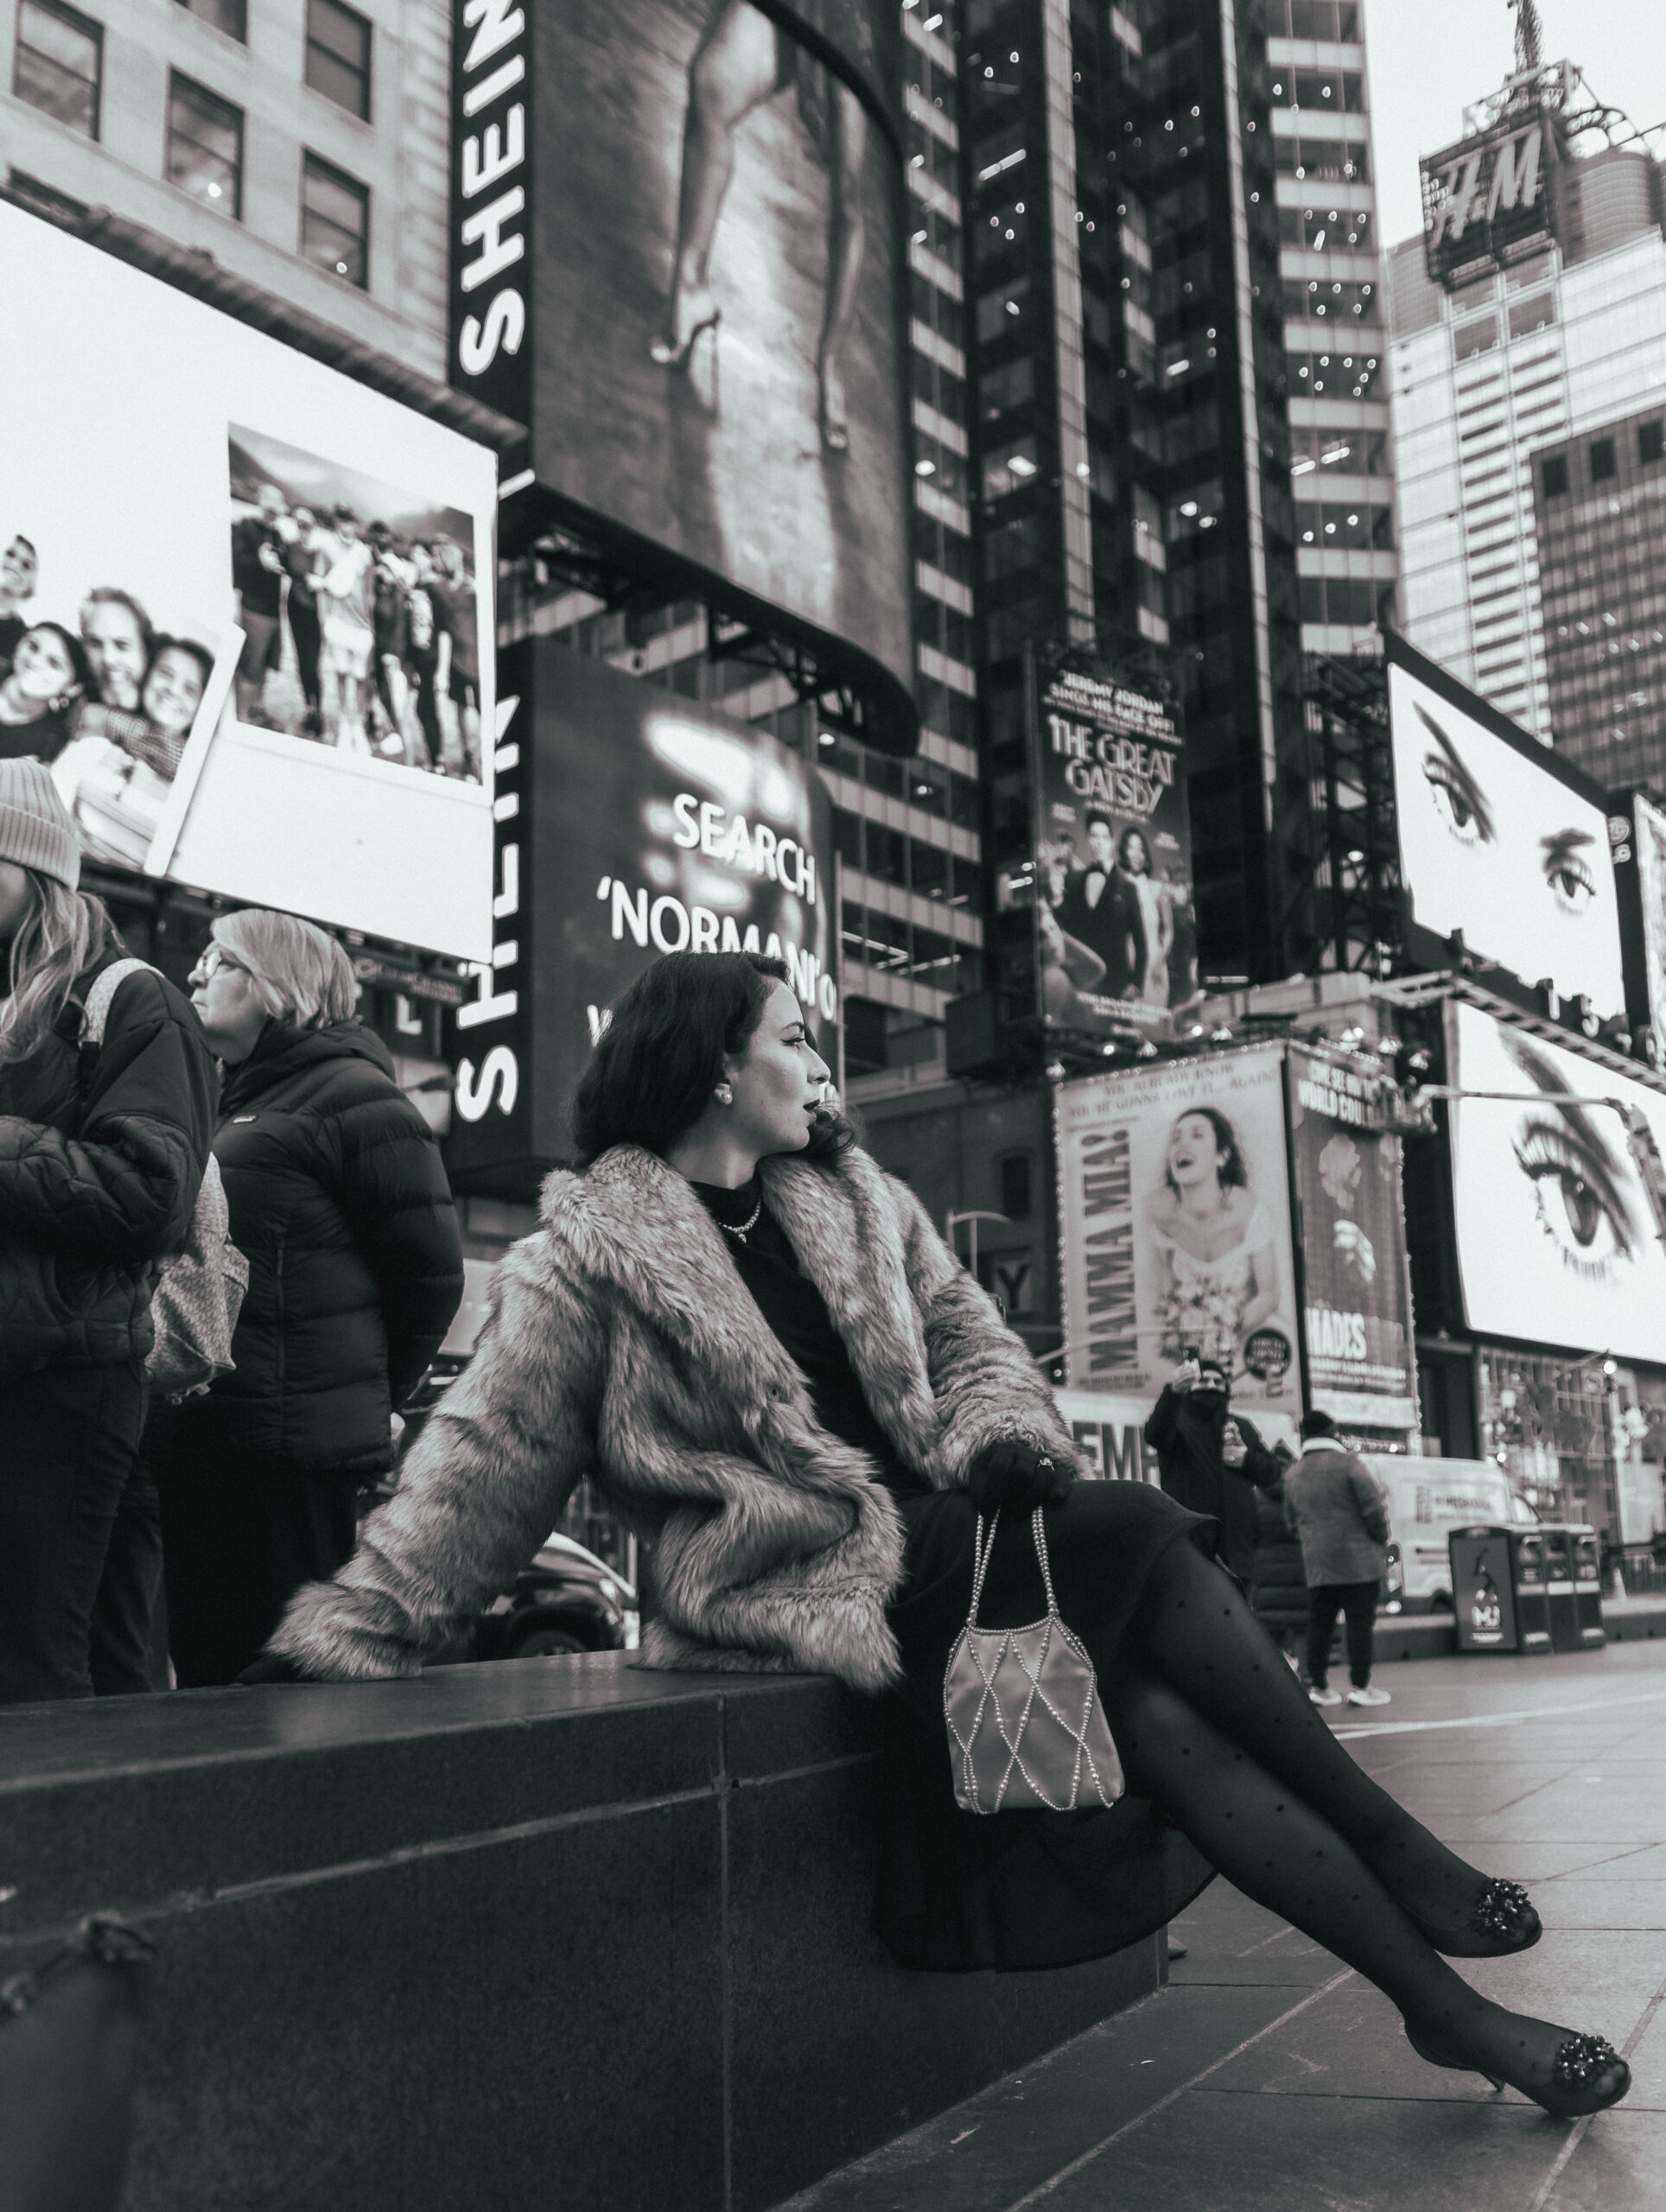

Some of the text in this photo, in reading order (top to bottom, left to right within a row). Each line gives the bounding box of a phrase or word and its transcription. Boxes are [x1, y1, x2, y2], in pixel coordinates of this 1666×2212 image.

[459, 0, 525, 376] SHEIN
[1048, 715, 1094, 762] THE
[1097, 734, 1177, 786] GREAT
[672, 793, 815, 905] SEARCH
[1195, 1064, 1235, 1079] KNOW
[1081, 1129, 1132, 1219] MIA!
[1086, 1223, 1138, 1374] MAMMA
[1472, 1605, 1501, 1626] MJ
